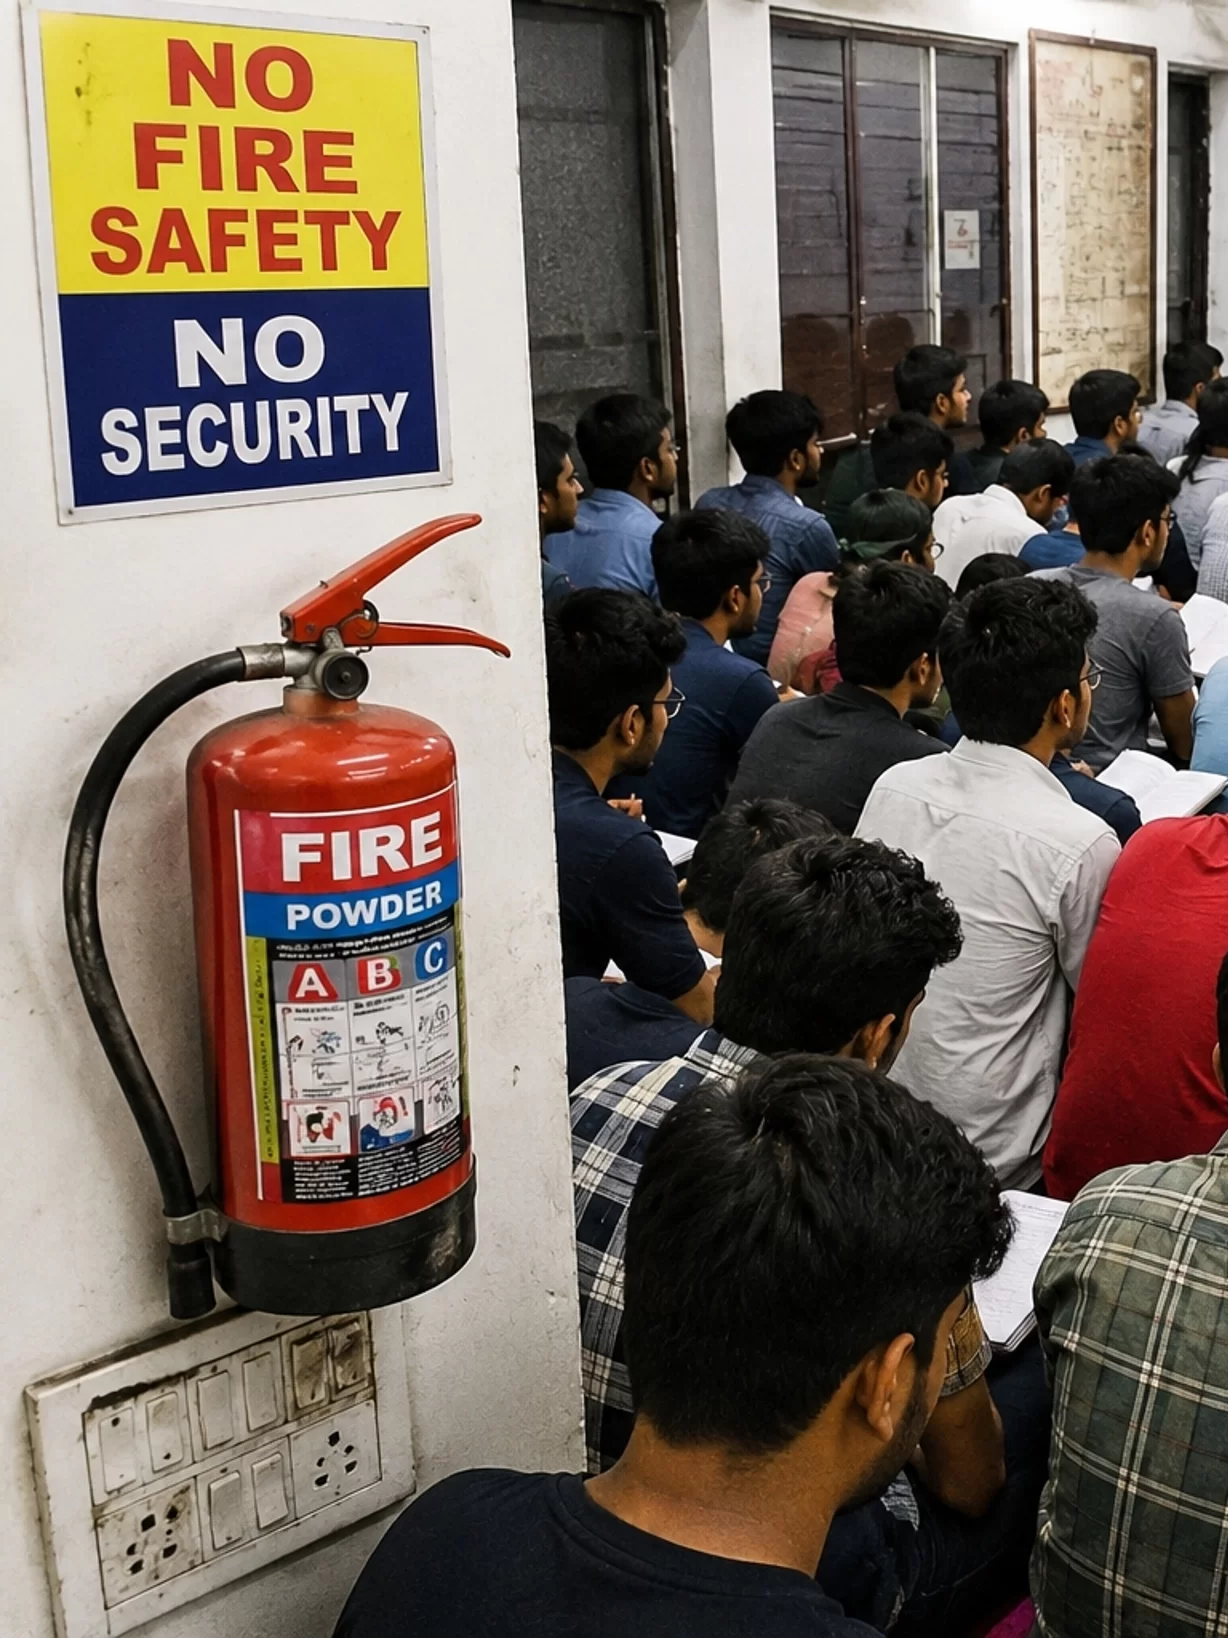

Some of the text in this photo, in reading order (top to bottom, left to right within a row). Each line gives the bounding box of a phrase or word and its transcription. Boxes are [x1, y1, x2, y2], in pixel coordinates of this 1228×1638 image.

[167, 38, 313, 112] NO
[133, 122, 358, 194] FIRE
[90, 206, 402, 276] SAFETY
[173, 315, 326, 388] NO
[100, 391, 409, 476] SECURITY
[281, 811, 443, 882] FIRE
[286, 880, 442, 931] POWDER
[295, 967, 329, 998] A
[367, 958, 394, 991] B
[424, 941, 443, 973] C
